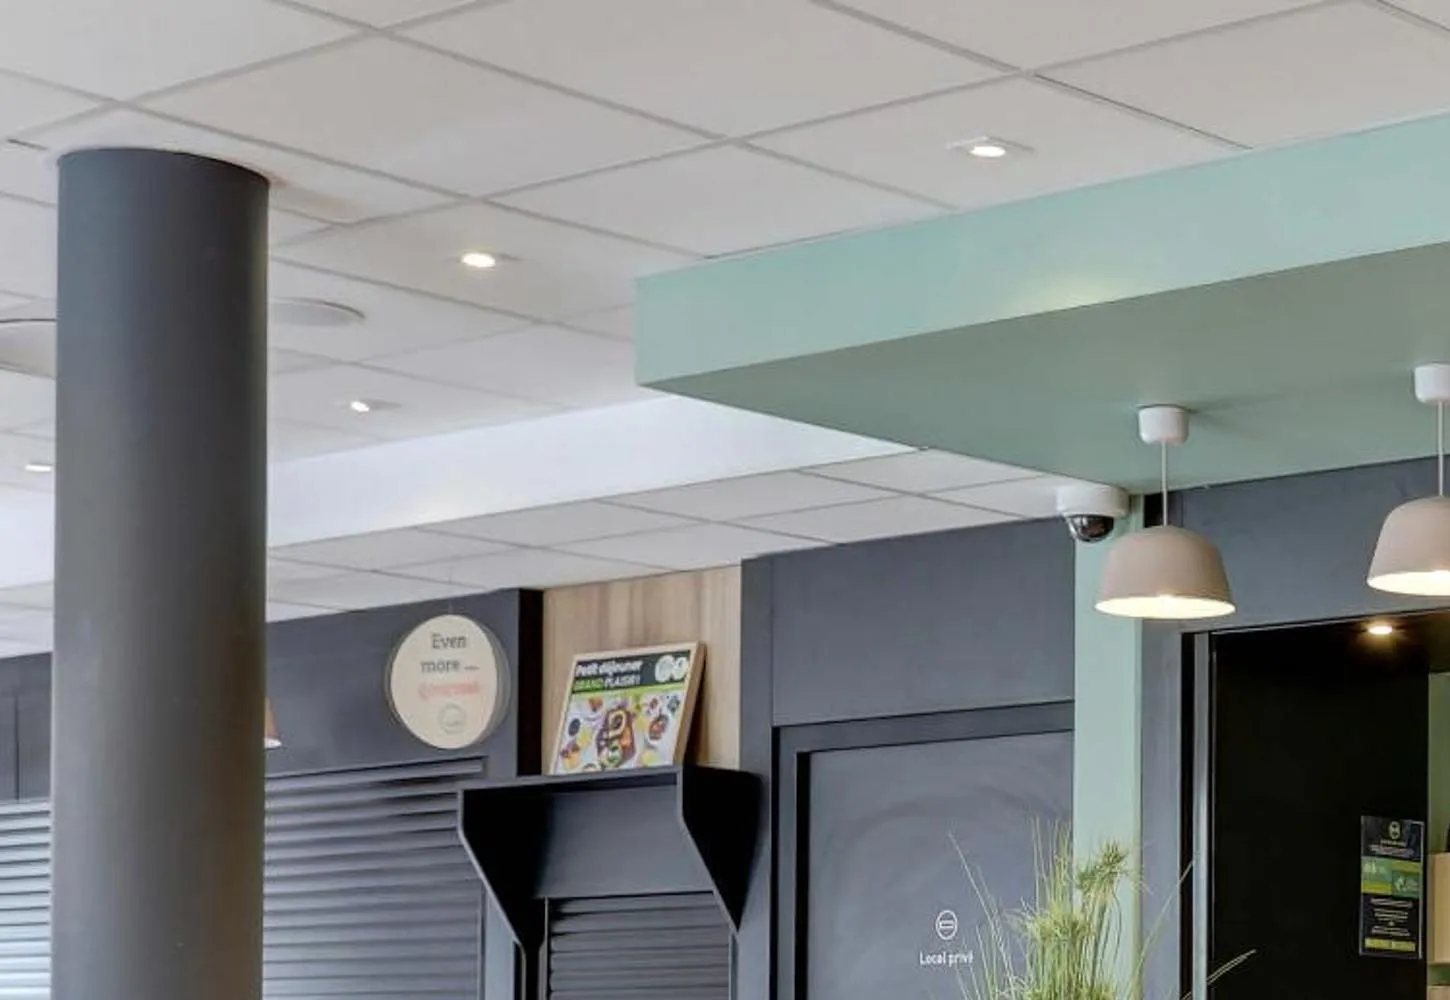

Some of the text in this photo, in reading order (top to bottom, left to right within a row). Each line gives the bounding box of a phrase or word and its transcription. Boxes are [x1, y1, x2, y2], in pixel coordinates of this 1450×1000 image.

[431, 633, 467, 648] Even
[420, 660, 460, 673] more
[920, 951, 946, 965] Local
